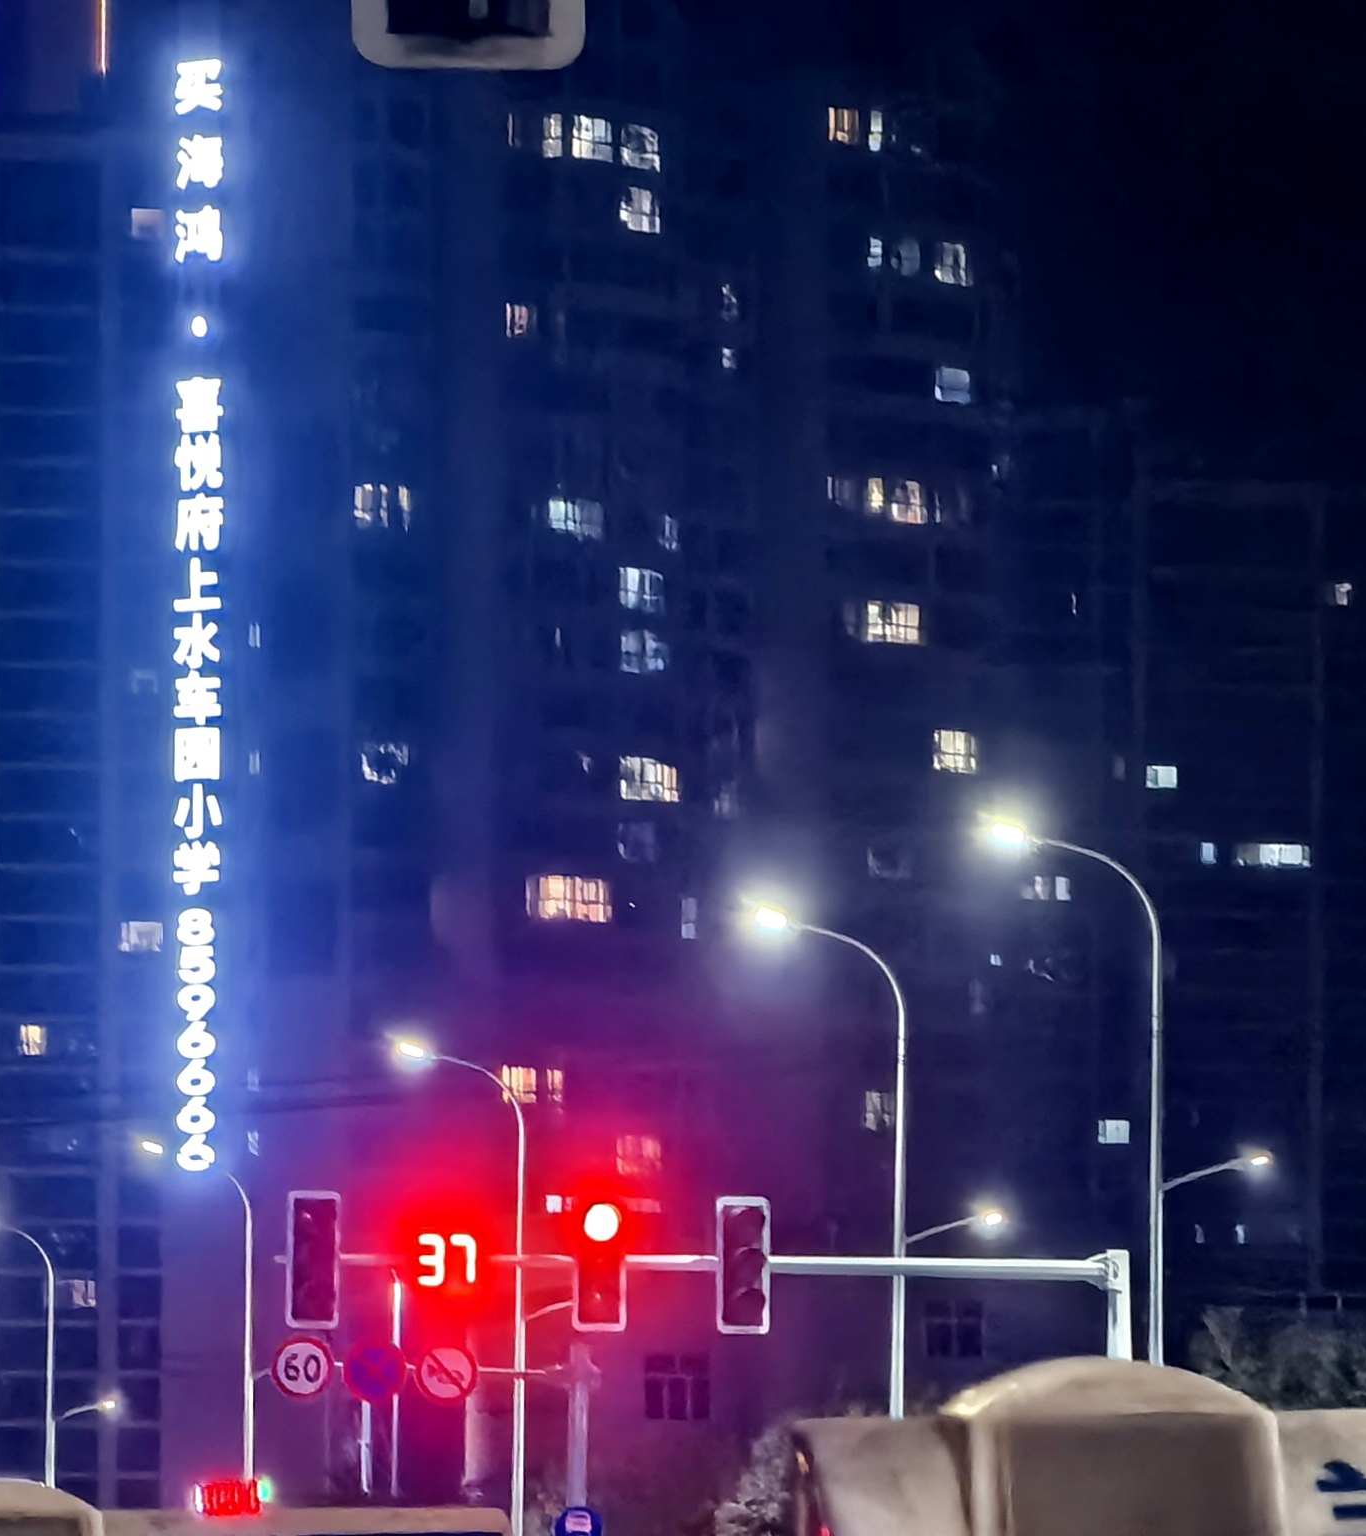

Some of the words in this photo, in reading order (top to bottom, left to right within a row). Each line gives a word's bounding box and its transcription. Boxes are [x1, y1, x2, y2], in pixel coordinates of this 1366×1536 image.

[175, 907, 217, 1172] 8596666
[417, 1232, 477, 1287] 37
[283, 1352, 322, 1383] 60
